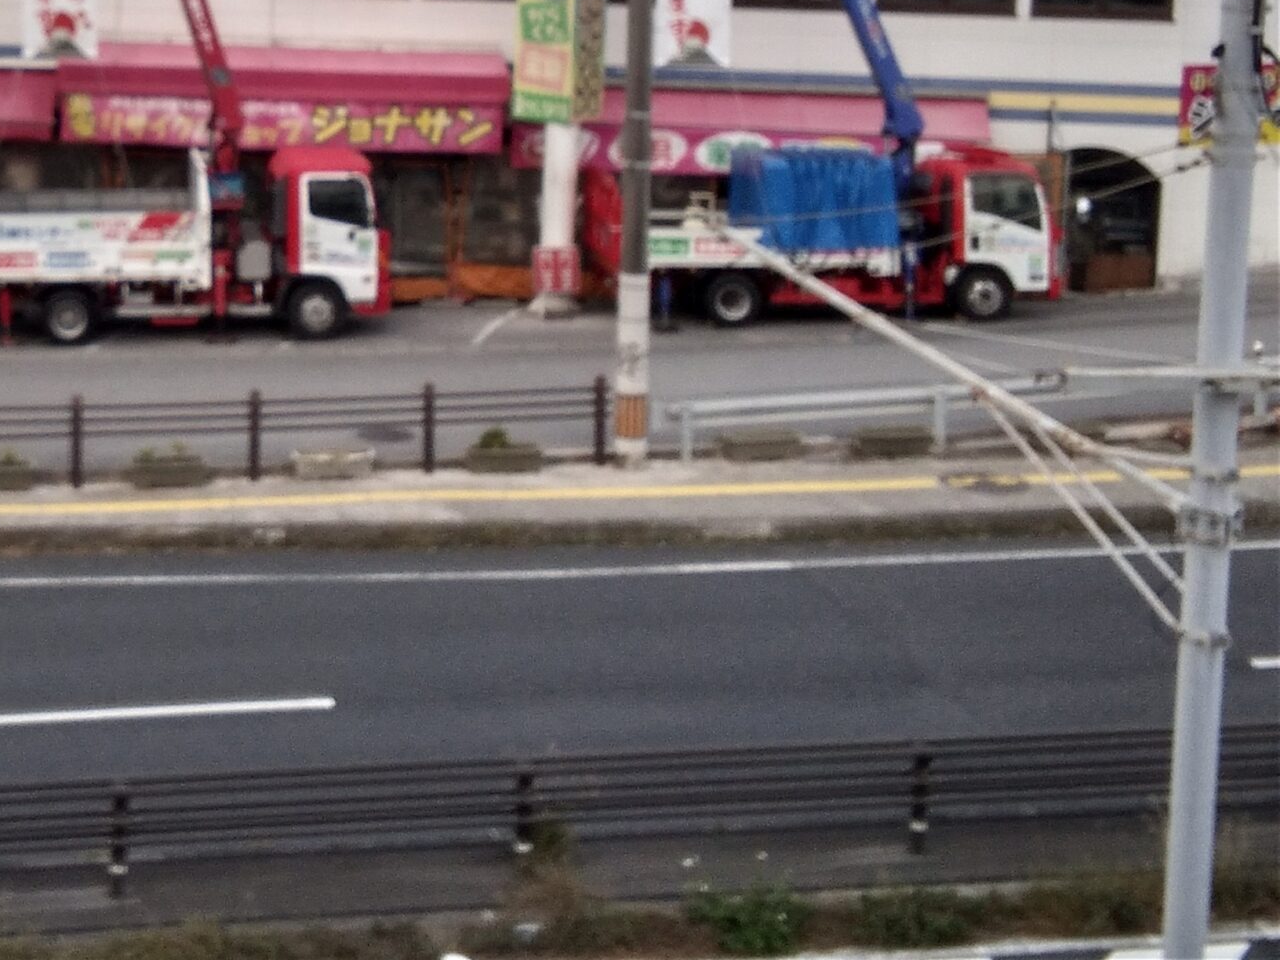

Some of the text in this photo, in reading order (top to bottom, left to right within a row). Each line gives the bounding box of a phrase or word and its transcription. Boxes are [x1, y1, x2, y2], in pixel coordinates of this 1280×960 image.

[312, 104, 493, 146] ジョナサン
